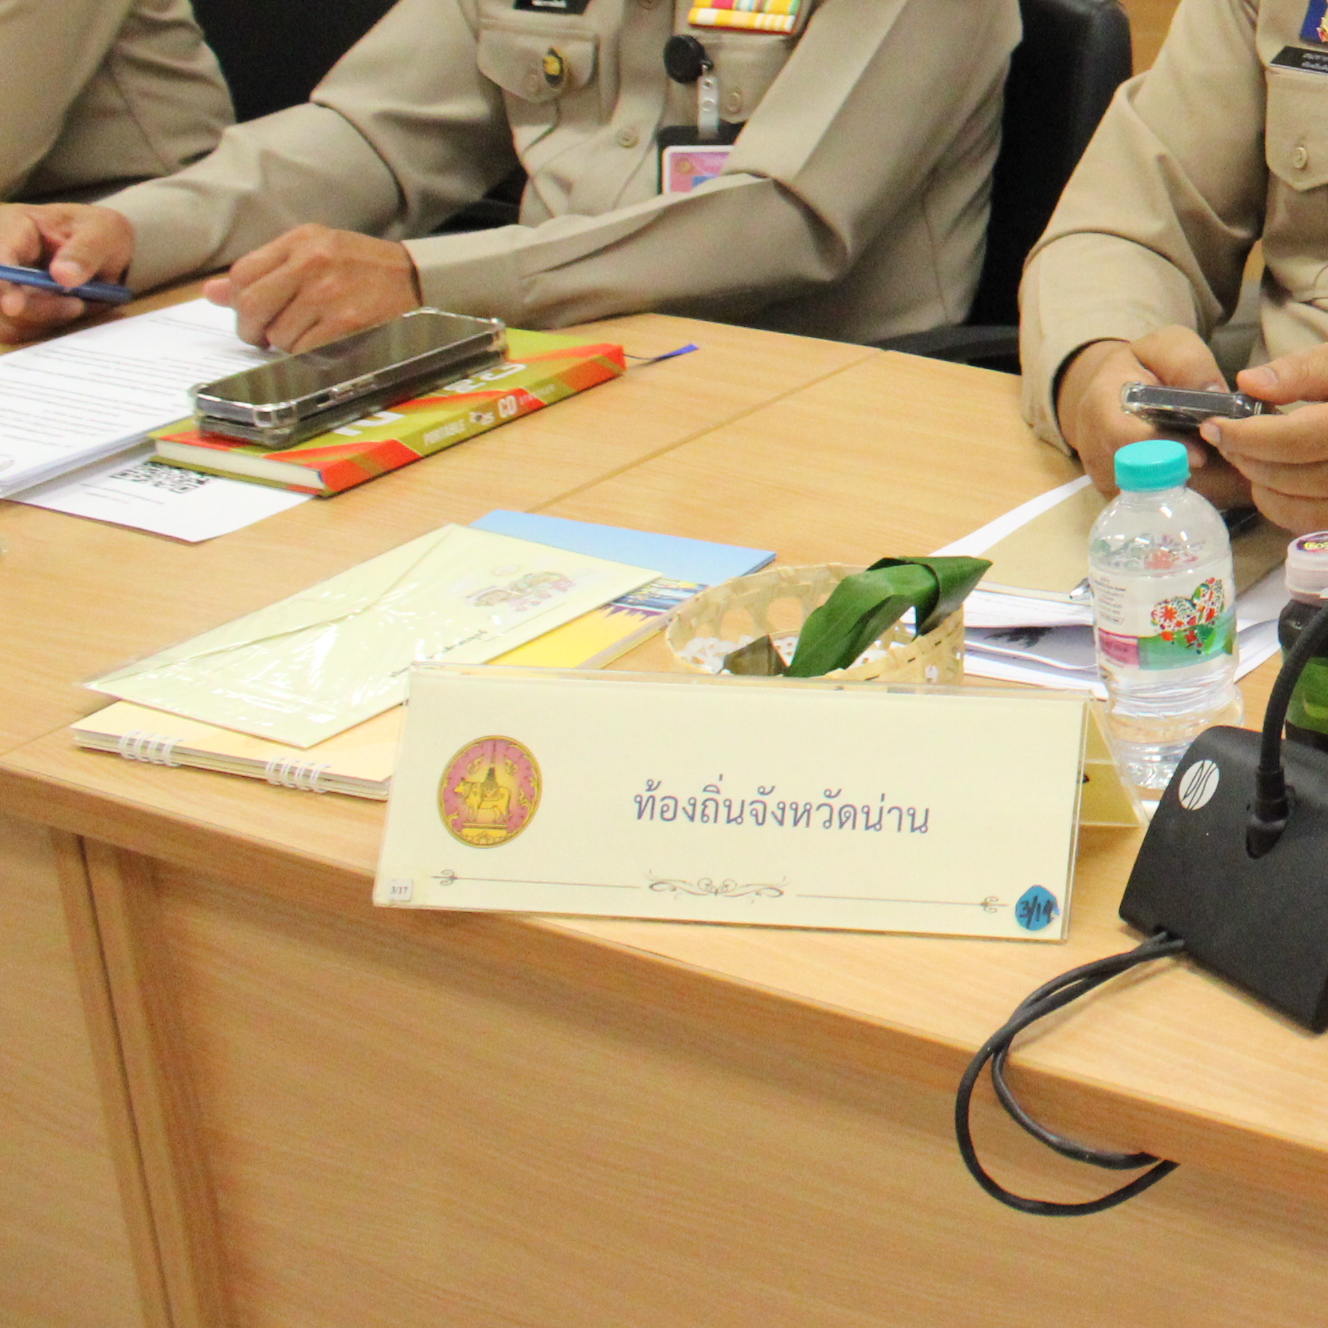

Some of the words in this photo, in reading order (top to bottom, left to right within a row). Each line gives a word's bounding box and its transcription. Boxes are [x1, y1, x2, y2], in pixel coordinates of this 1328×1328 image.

[633, 773, 932, 836] ท้องถิ่นจังหวัดน่าน
